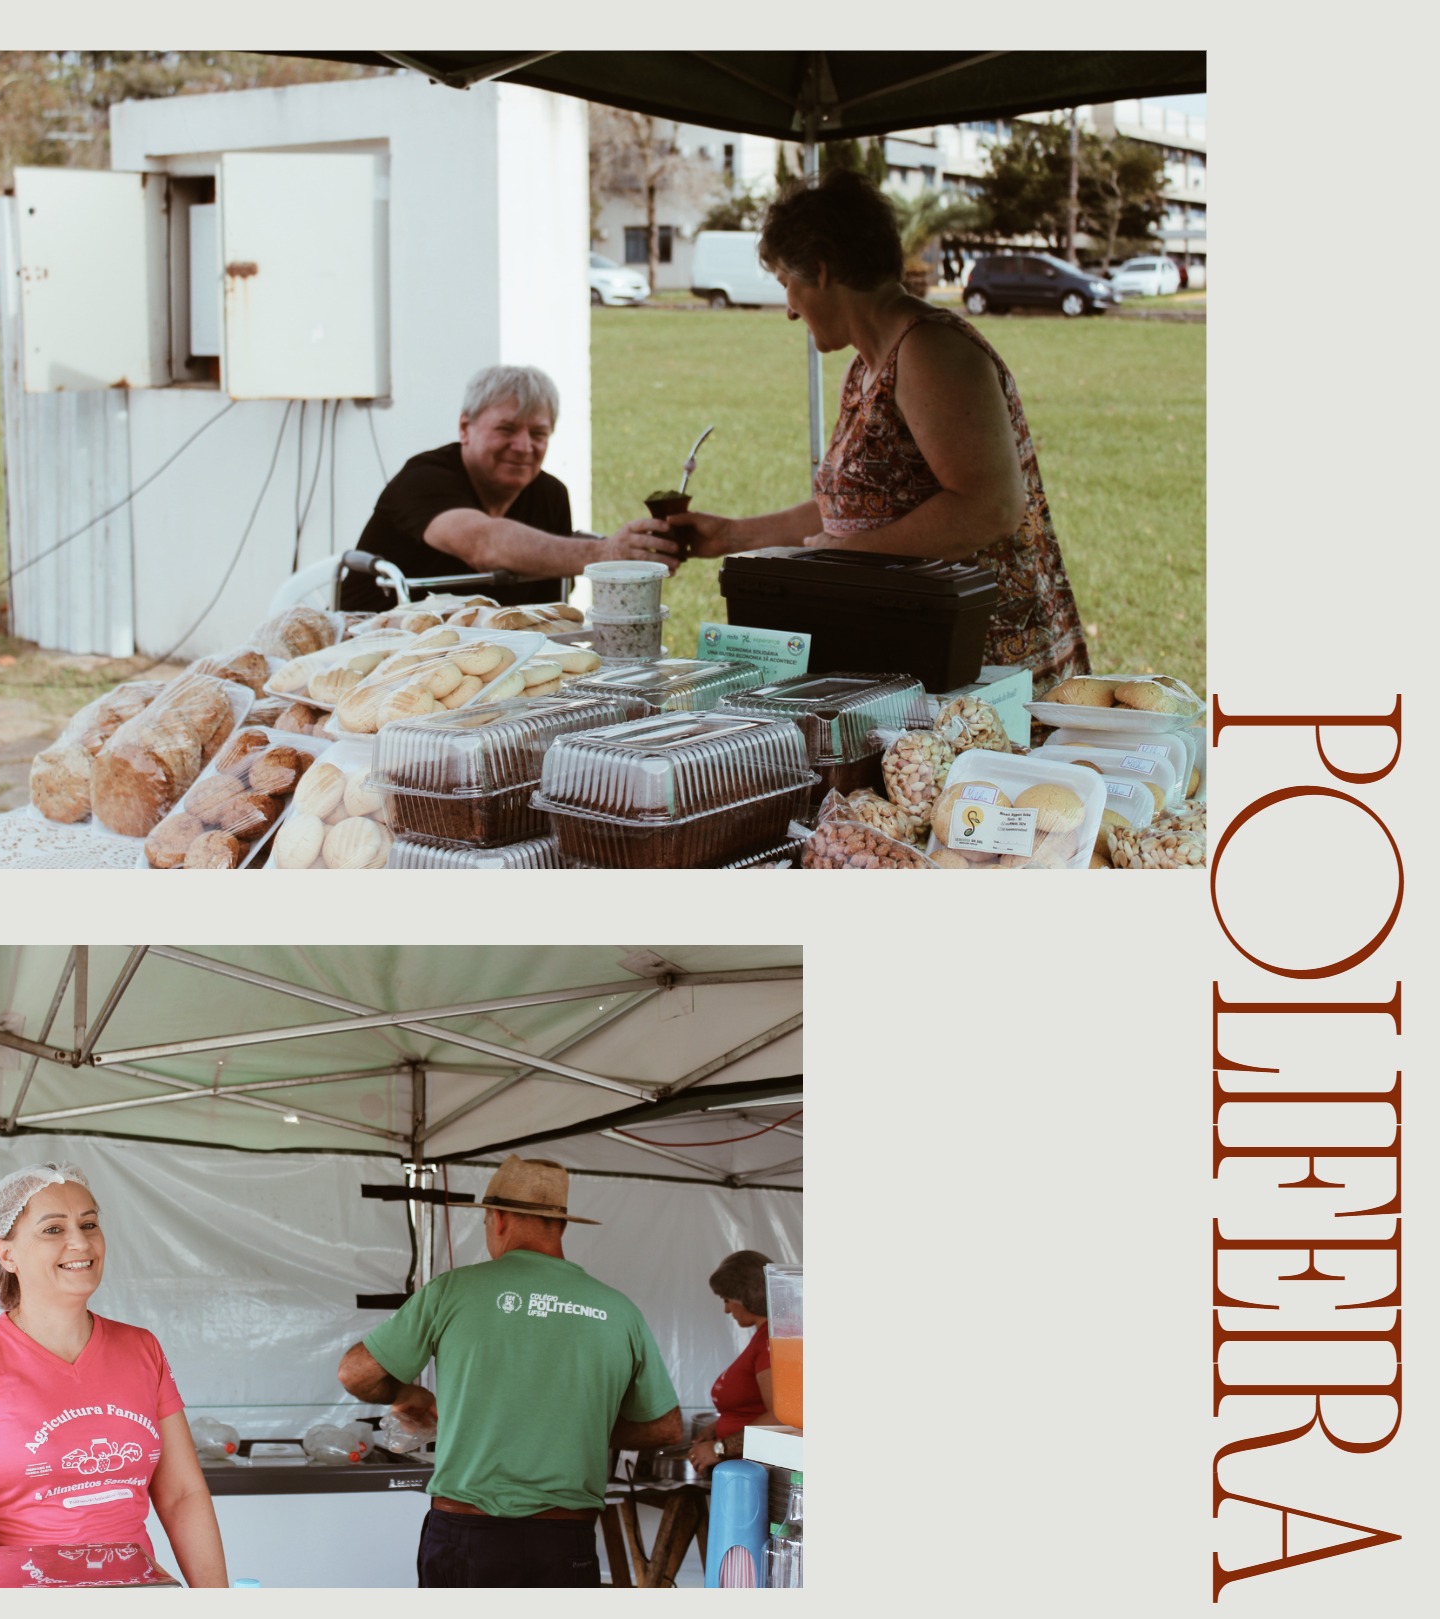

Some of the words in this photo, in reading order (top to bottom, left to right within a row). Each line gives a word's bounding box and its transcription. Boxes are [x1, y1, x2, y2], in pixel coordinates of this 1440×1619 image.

[736, 653, 762, 661] ECONOMIA
[529, 1292, 559, 1302] COLÉGIO
[527, 1309, 548, 1318] UFSM
[528, 1299, 608, 1321] POLITÉCNICO
[24, 1405, 104, 1455] Agricultura
[106, 1403, 160, 1440] Familiar
[35, 1492, 43, 1501] &
[44, 1480, 102, 1498] Alimentos
